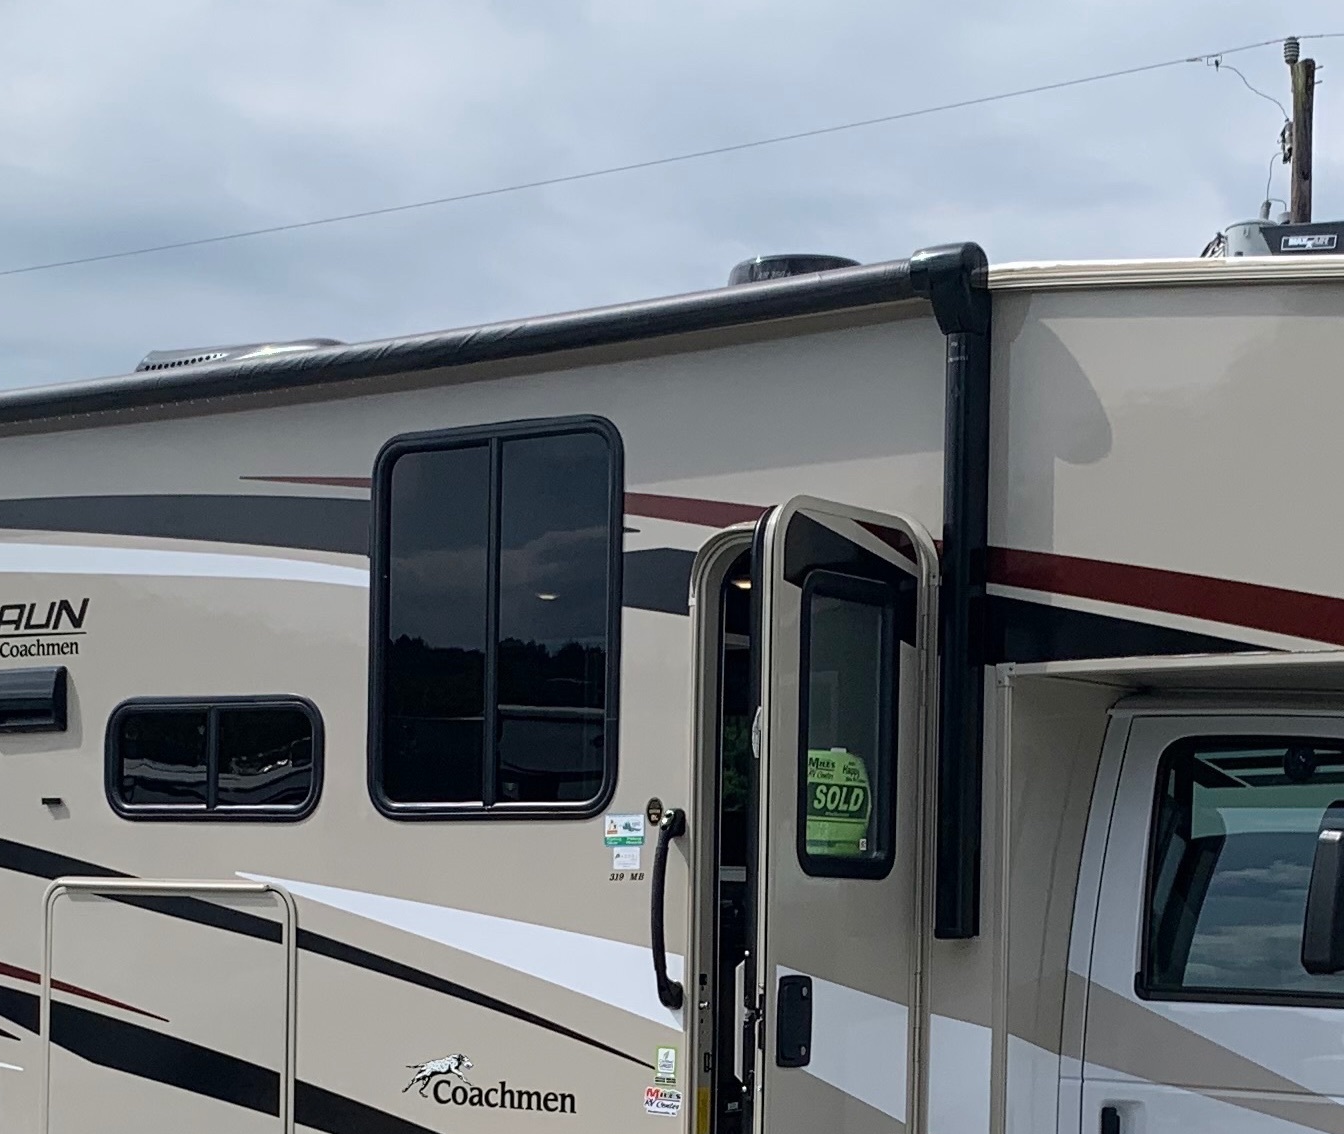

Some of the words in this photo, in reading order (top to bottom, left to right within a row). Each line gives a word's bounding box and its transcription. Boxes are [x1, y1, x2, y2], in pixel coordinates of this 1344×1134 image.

[0, 639, 79, 658] Coachmen
[813, 784, 864, 811] SOLD
[609, 872, 624, 881] 319
[433, 1079, 577, 1114] Coachmen
